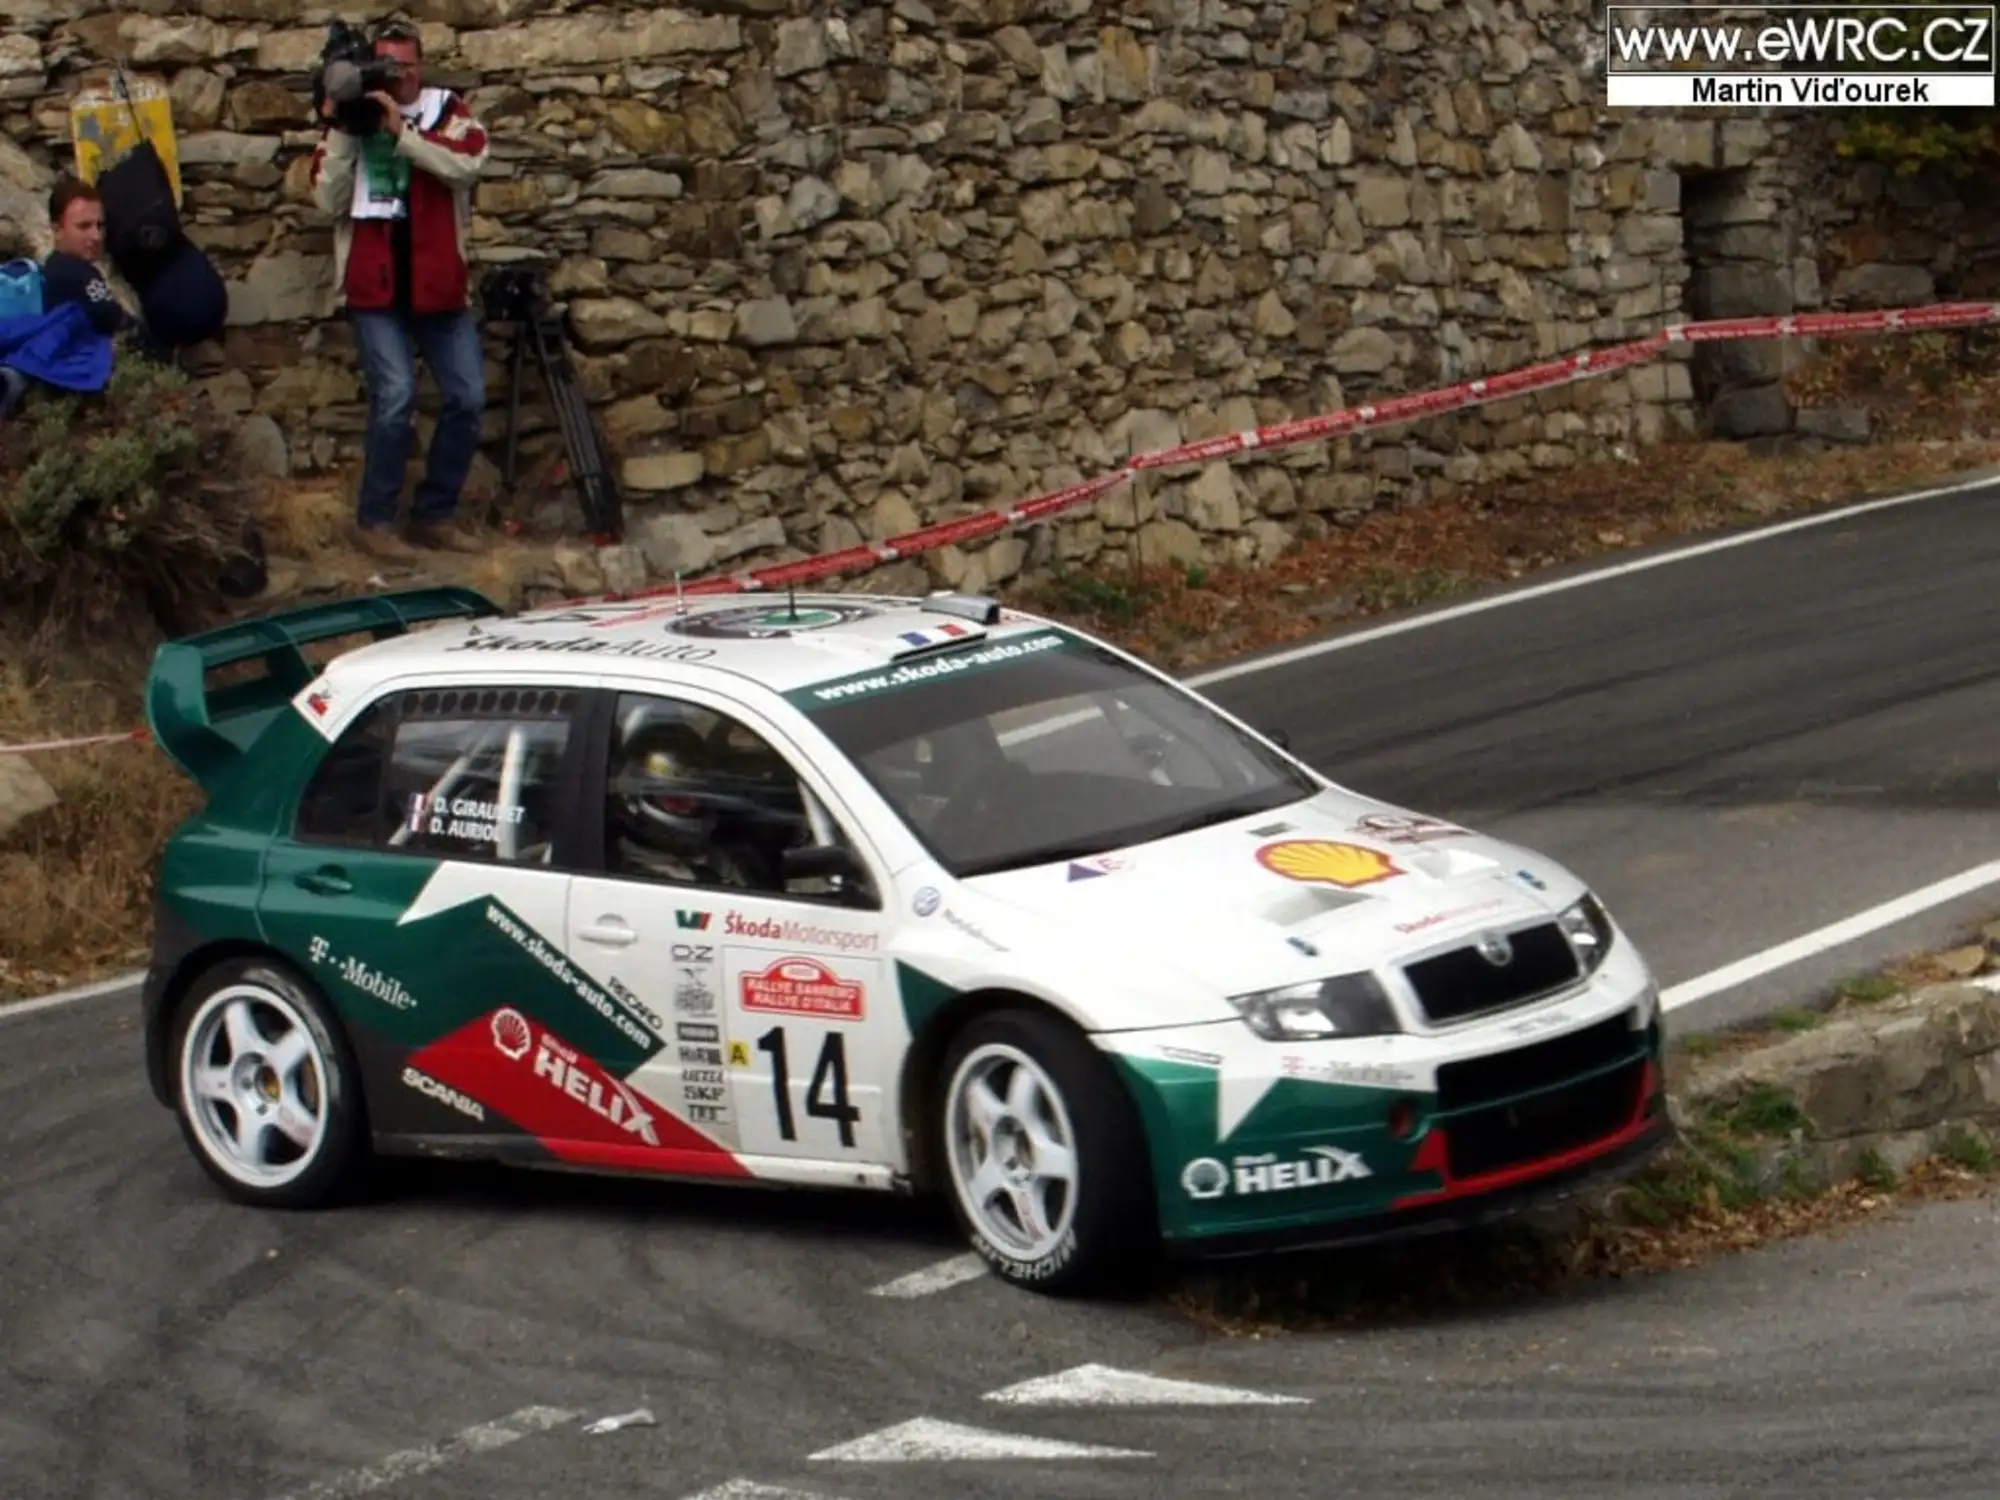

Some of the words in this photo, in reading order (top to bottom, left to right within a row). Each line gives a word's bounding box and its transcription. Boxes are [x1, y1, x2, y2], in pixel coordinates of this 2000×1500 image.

[486, 903, 652, 1051] www.skoda-auto.com
[402, 1066, 484, 1122] SCANIA
[534, 1046, 660, 1146] HELIX
[730, 1043, 746, 1065] A
[757, 1026, 861, 1147] 14
[1235, 1146, 1373, 1194] HELIX
